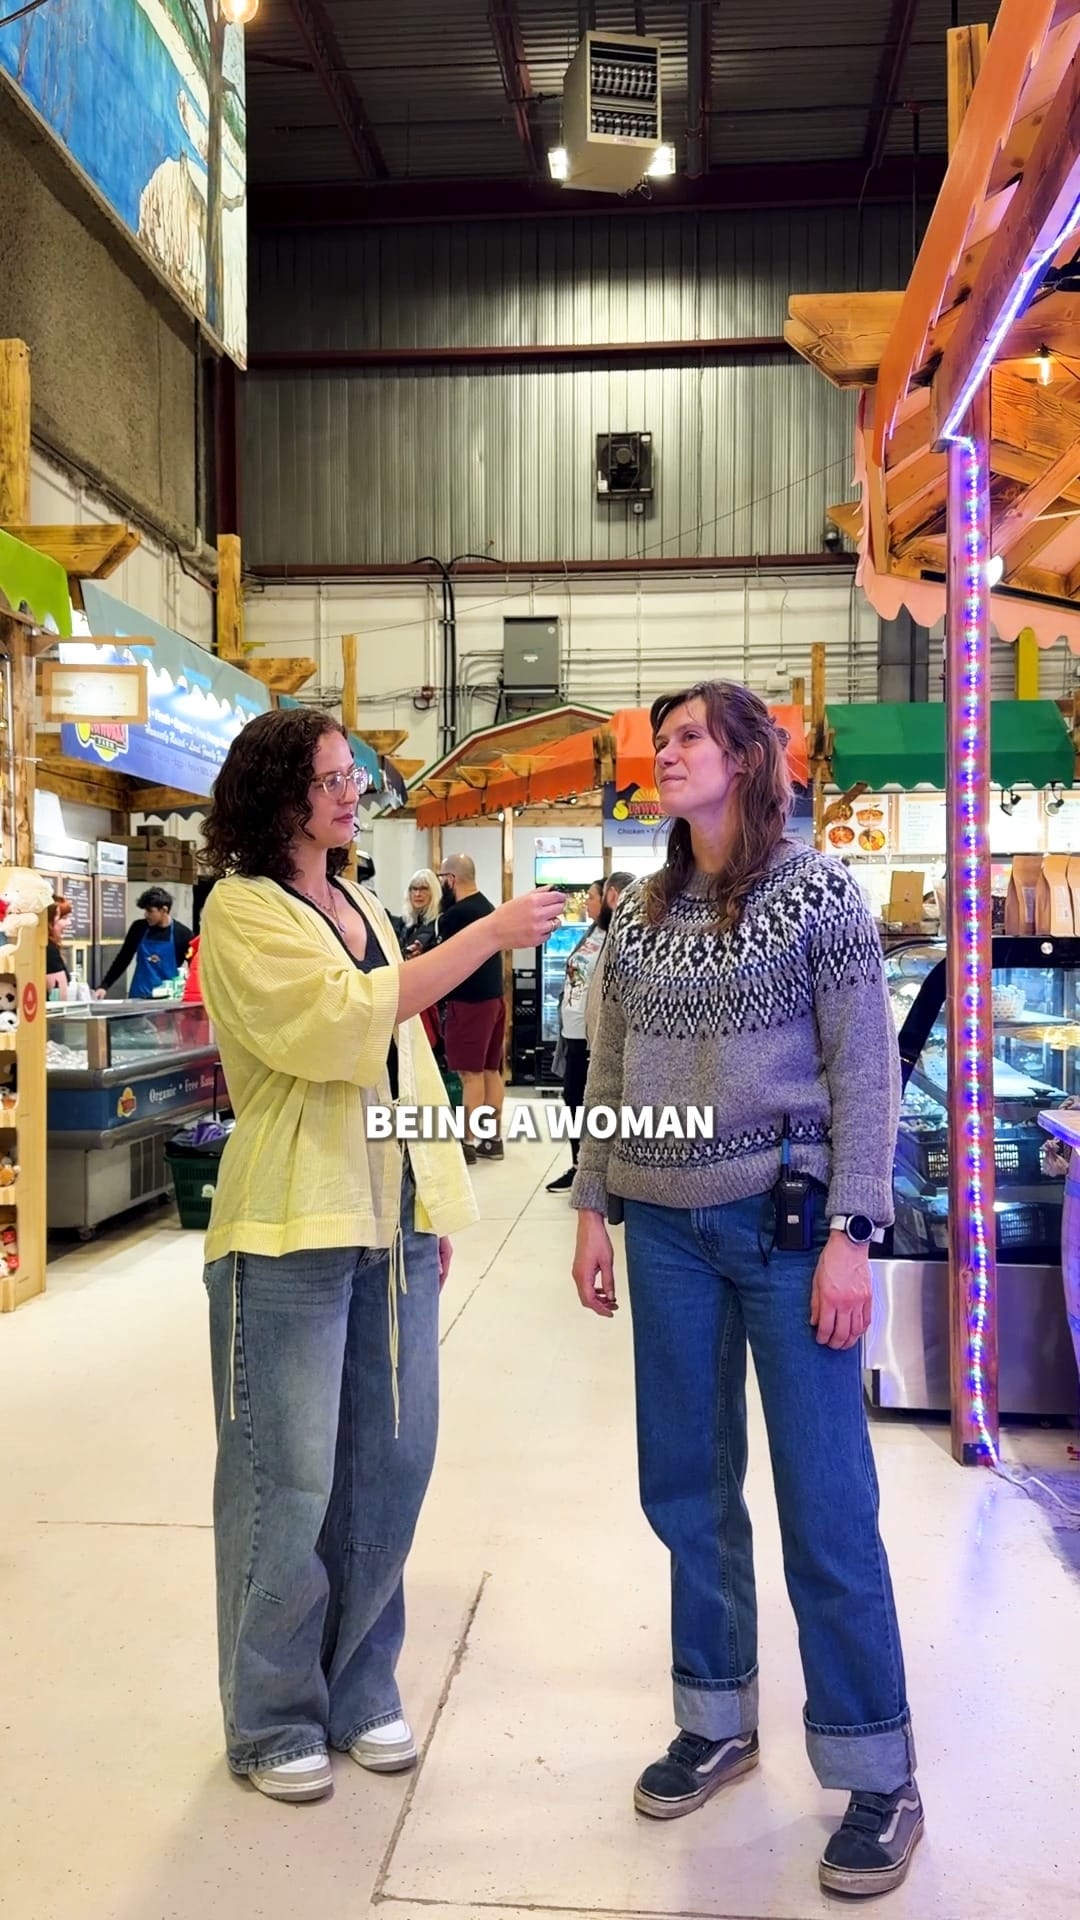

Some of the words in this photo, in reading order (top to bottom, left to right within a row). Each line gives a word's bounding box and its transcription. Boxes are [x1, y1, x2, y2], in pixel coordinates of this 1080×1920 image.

[617, 827, 646, 835] Chicken
[149, 1084, 177, 1104] Organic
[185, 1078, 199, 1093] Free
